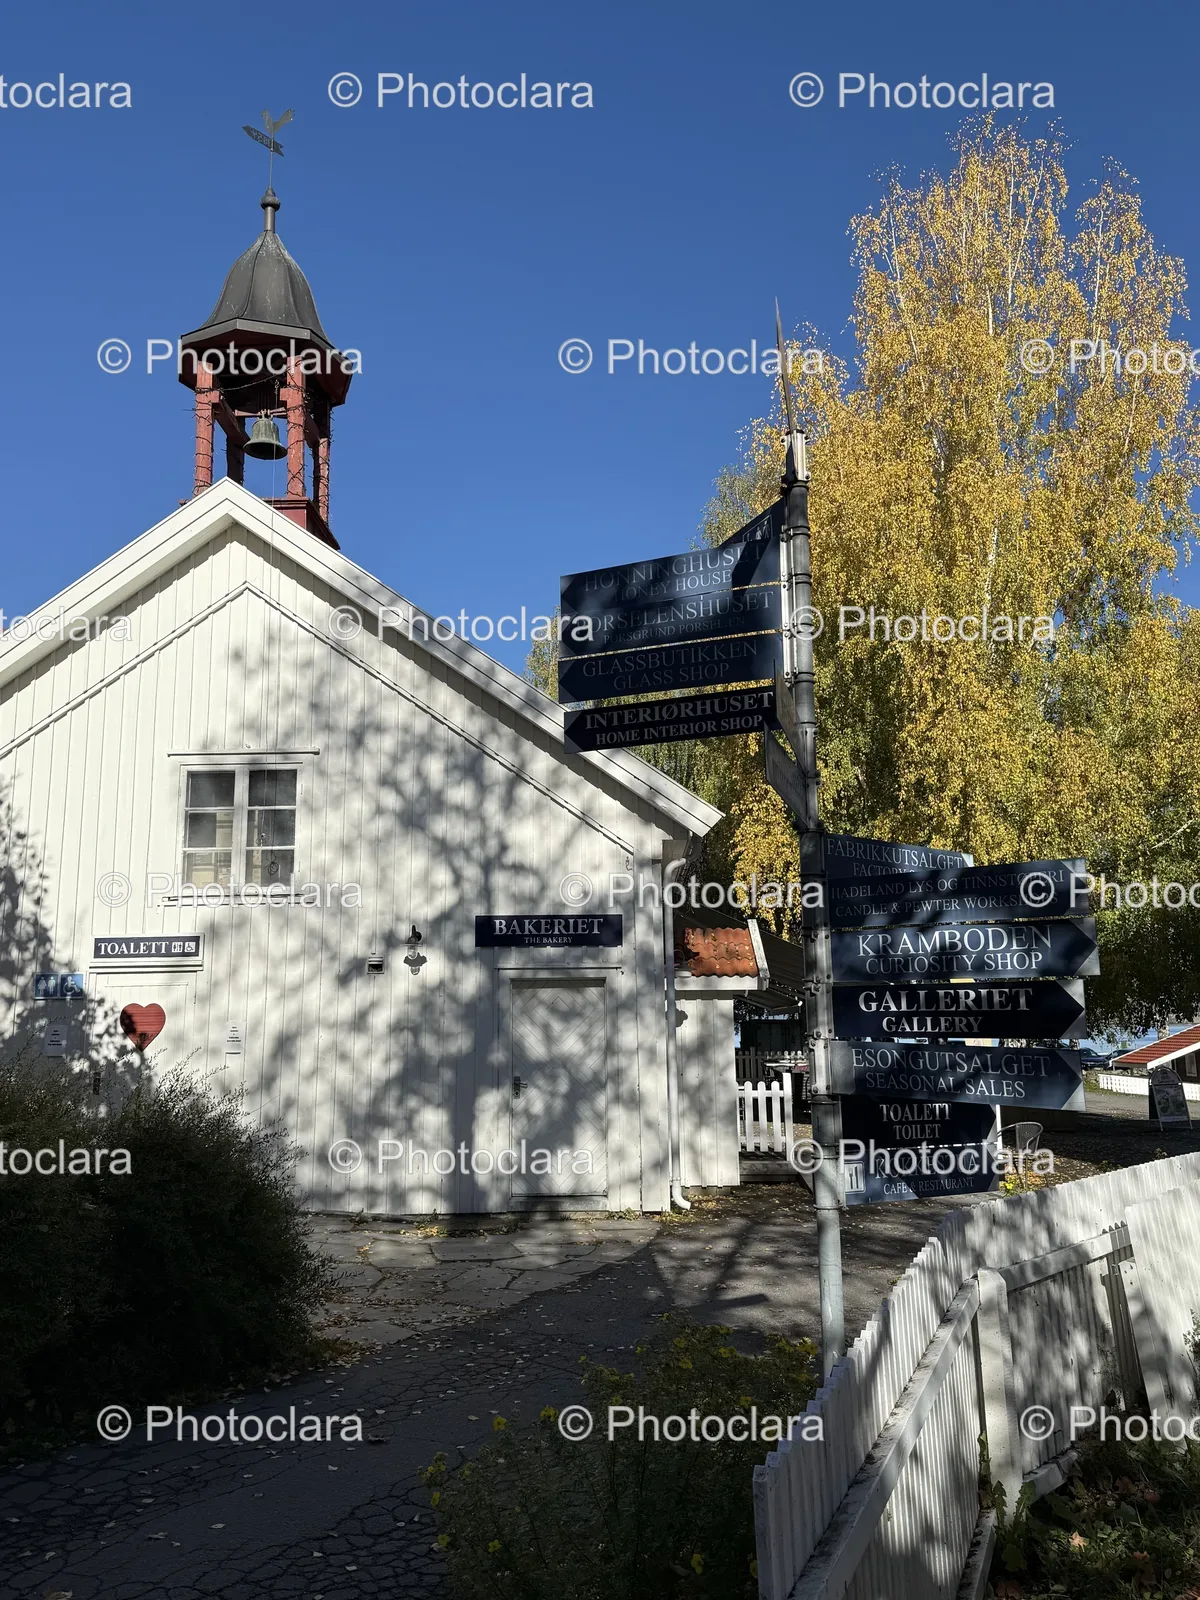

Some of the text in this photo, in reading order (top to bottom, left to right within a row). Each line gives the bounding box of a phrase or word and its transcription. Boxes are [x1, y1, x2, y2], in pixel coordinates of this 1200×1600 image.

[584, 542, 766, 591] HONNINGHUSET
[614, 569, 732, 602] HONEY HOUSE
[604, 625, 675, 644] PORSGRUND
[583, 639, 757, 677] GLASSBUTIKKEN
[613, 662, 729, 691] GLASS SHOP
[585, 691, 774, 729] INTERIØRHUSET
[596, 714, 763, 745] HOME INTERIOR SHOP
[826, 838, 964, 869] FABRIKKUTSALGET
[831, 882, 904, 899] HADELAND
[908, 880, 933, 894] LYS
[937, 878, 958, 891] OG
[836, 903, 888, 917] CANDLE
[890, 902, 901, 914] &
[904, 899, 960, 914] PEWTER
[493, 918, 604, 935] BAKERIET
[98, 941, 169, 955] TOALETT
[542, 936, 573, 944] BAKERY
[857, 925, 1052, 957] KRAMBODEN
[866, 951, 1043, 975] CURIOSITY SHOP
[858, 988, 1033, 1012] GALLERIET
[882, 1016, 982, 1033] GALLERY
[865, 1072, 1026, 1098] SEASONAL SALES
[880, 1103, 952, 1122] TOALETT
[893, 1124, 941, 1140] TOILET
[883, 1182, 907, 1195] CAFE
[918, 1176, 975, 1192] RESTAURANT
